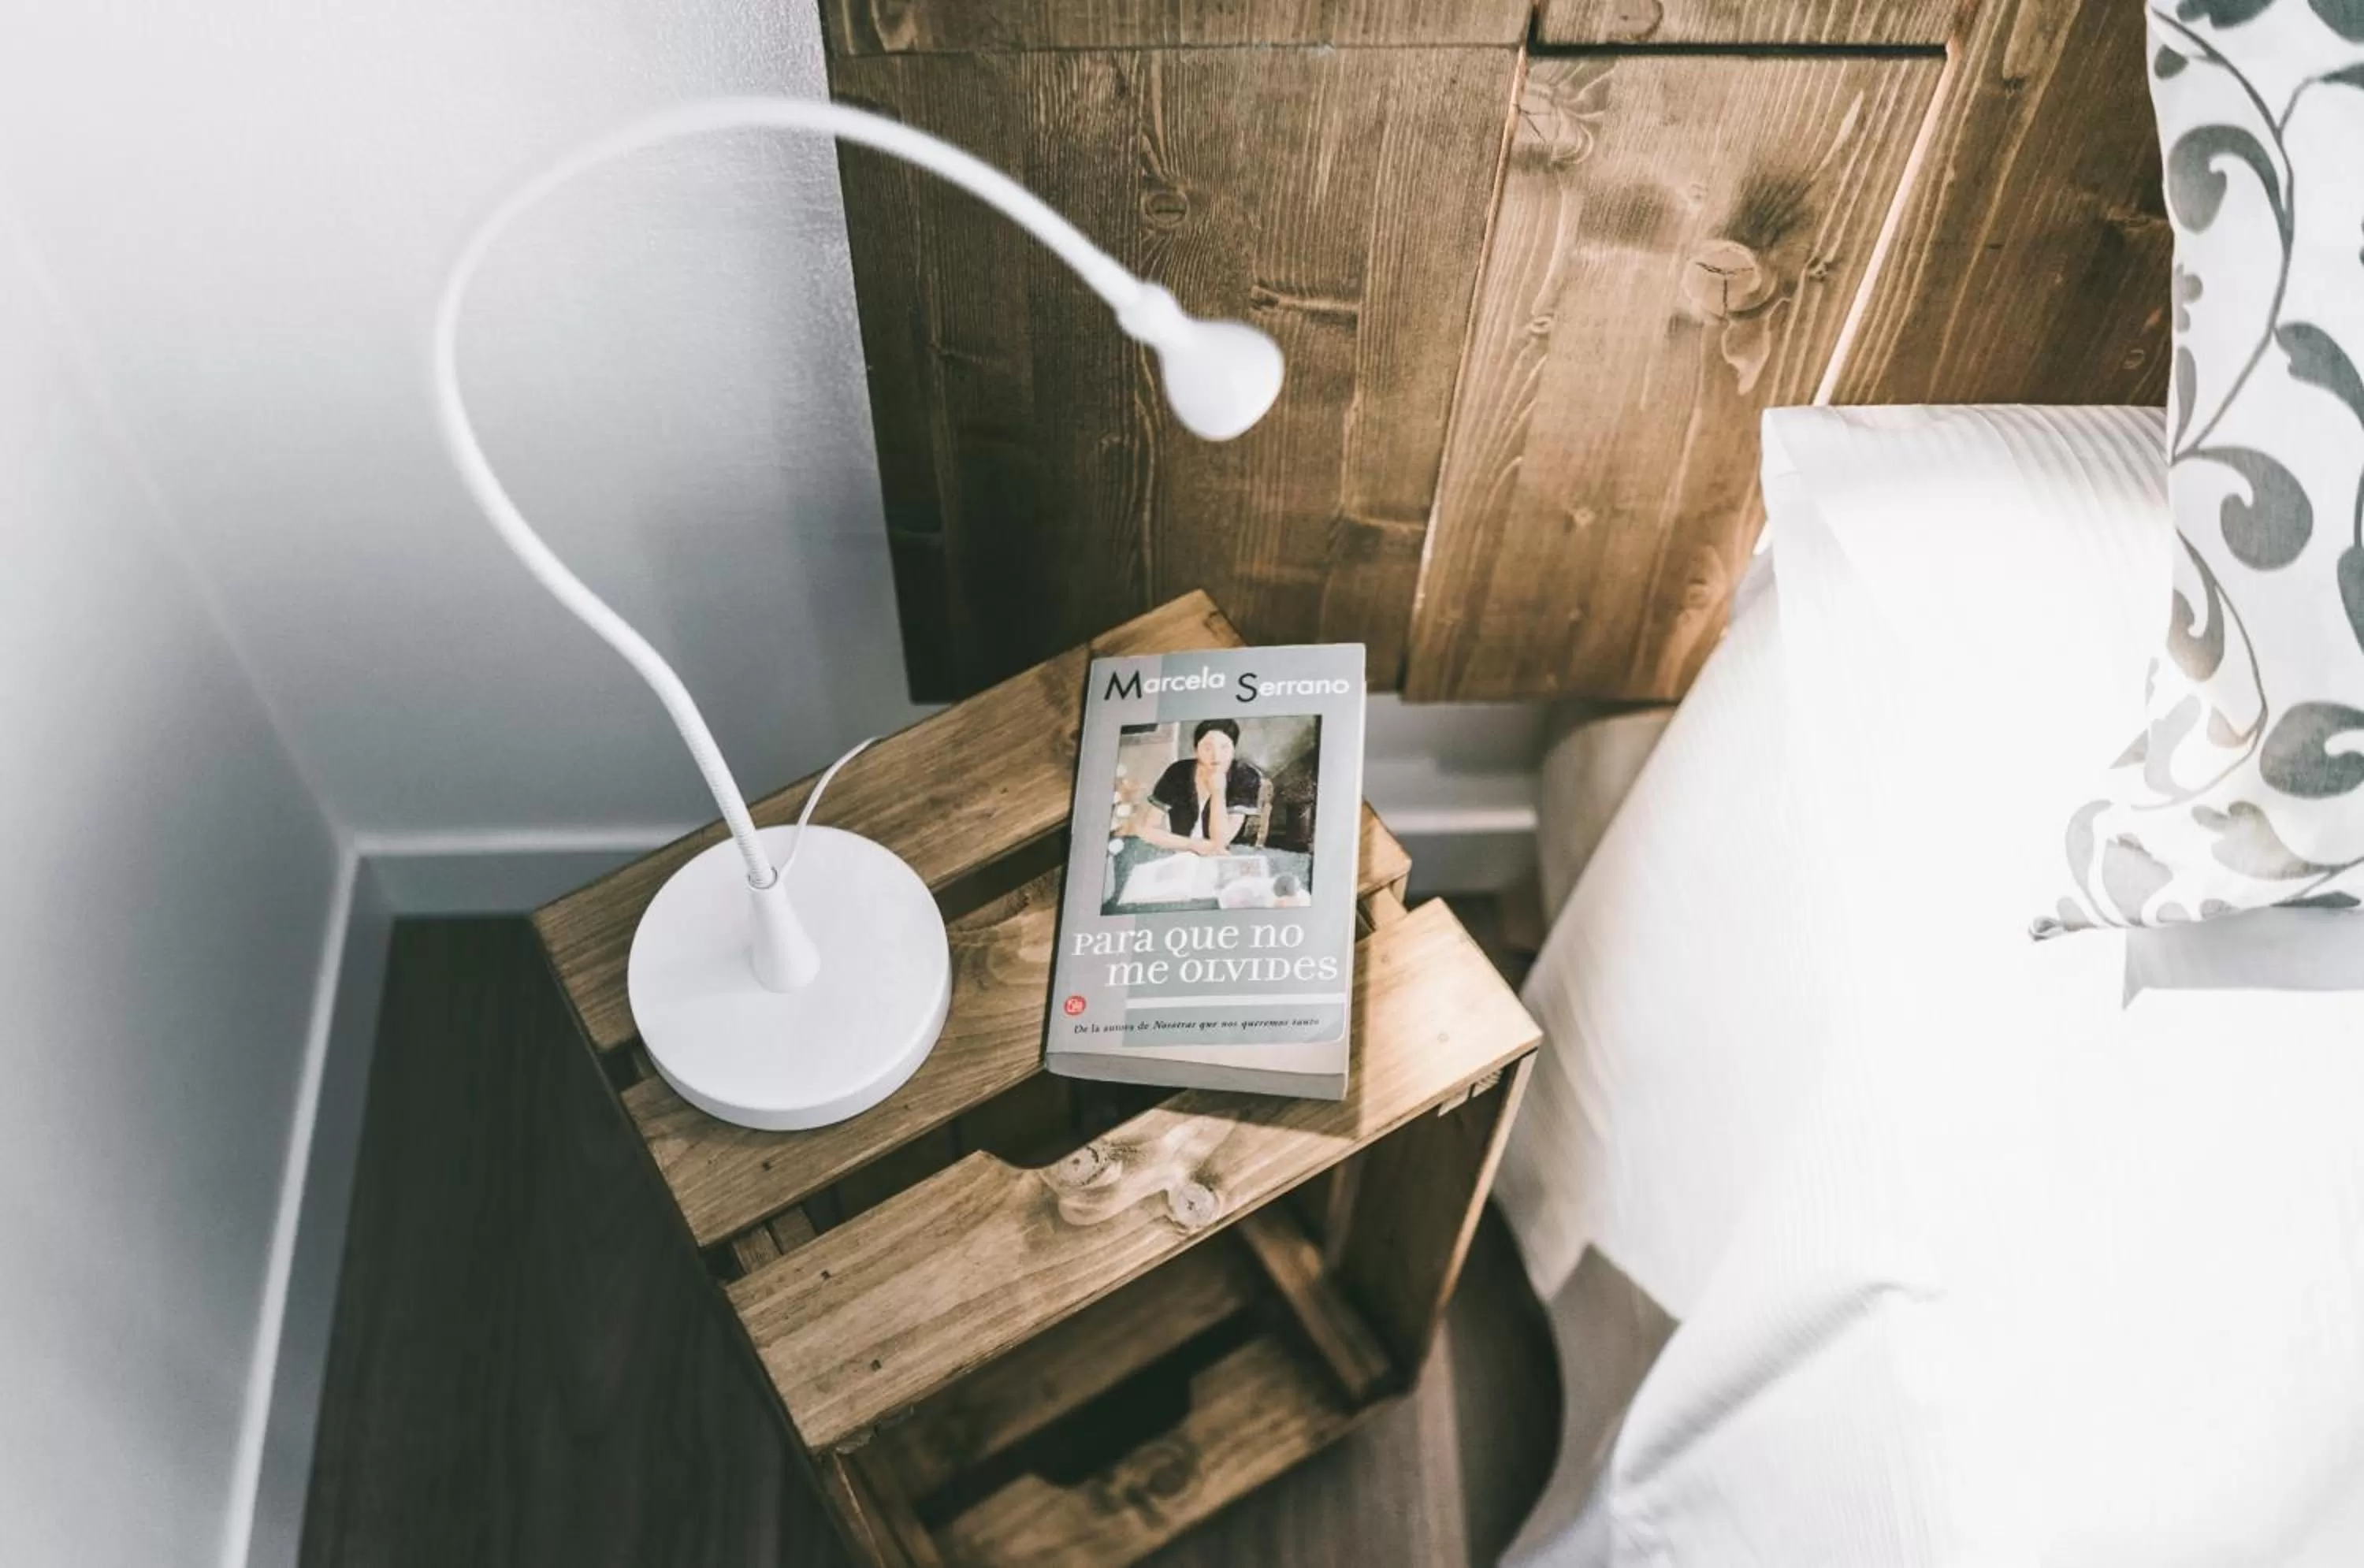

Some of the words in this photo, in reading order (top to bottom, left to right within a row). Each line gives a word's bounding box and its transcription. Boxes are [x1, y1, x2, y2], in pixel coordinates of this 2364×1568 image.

[1104, 666, 1226, 700] Marcela
[1236, 672, 1350, 703] Serrano
[1251, 923, 1305, 948] no
[1105, 959, 1169, 987] me
[1074, 1024, 1089, 1034] De
[1091, 1024, 1101, 1033] la
[1137, 1021, 1150, 1031] de
[1199, 1020, 1217, 1031] que
